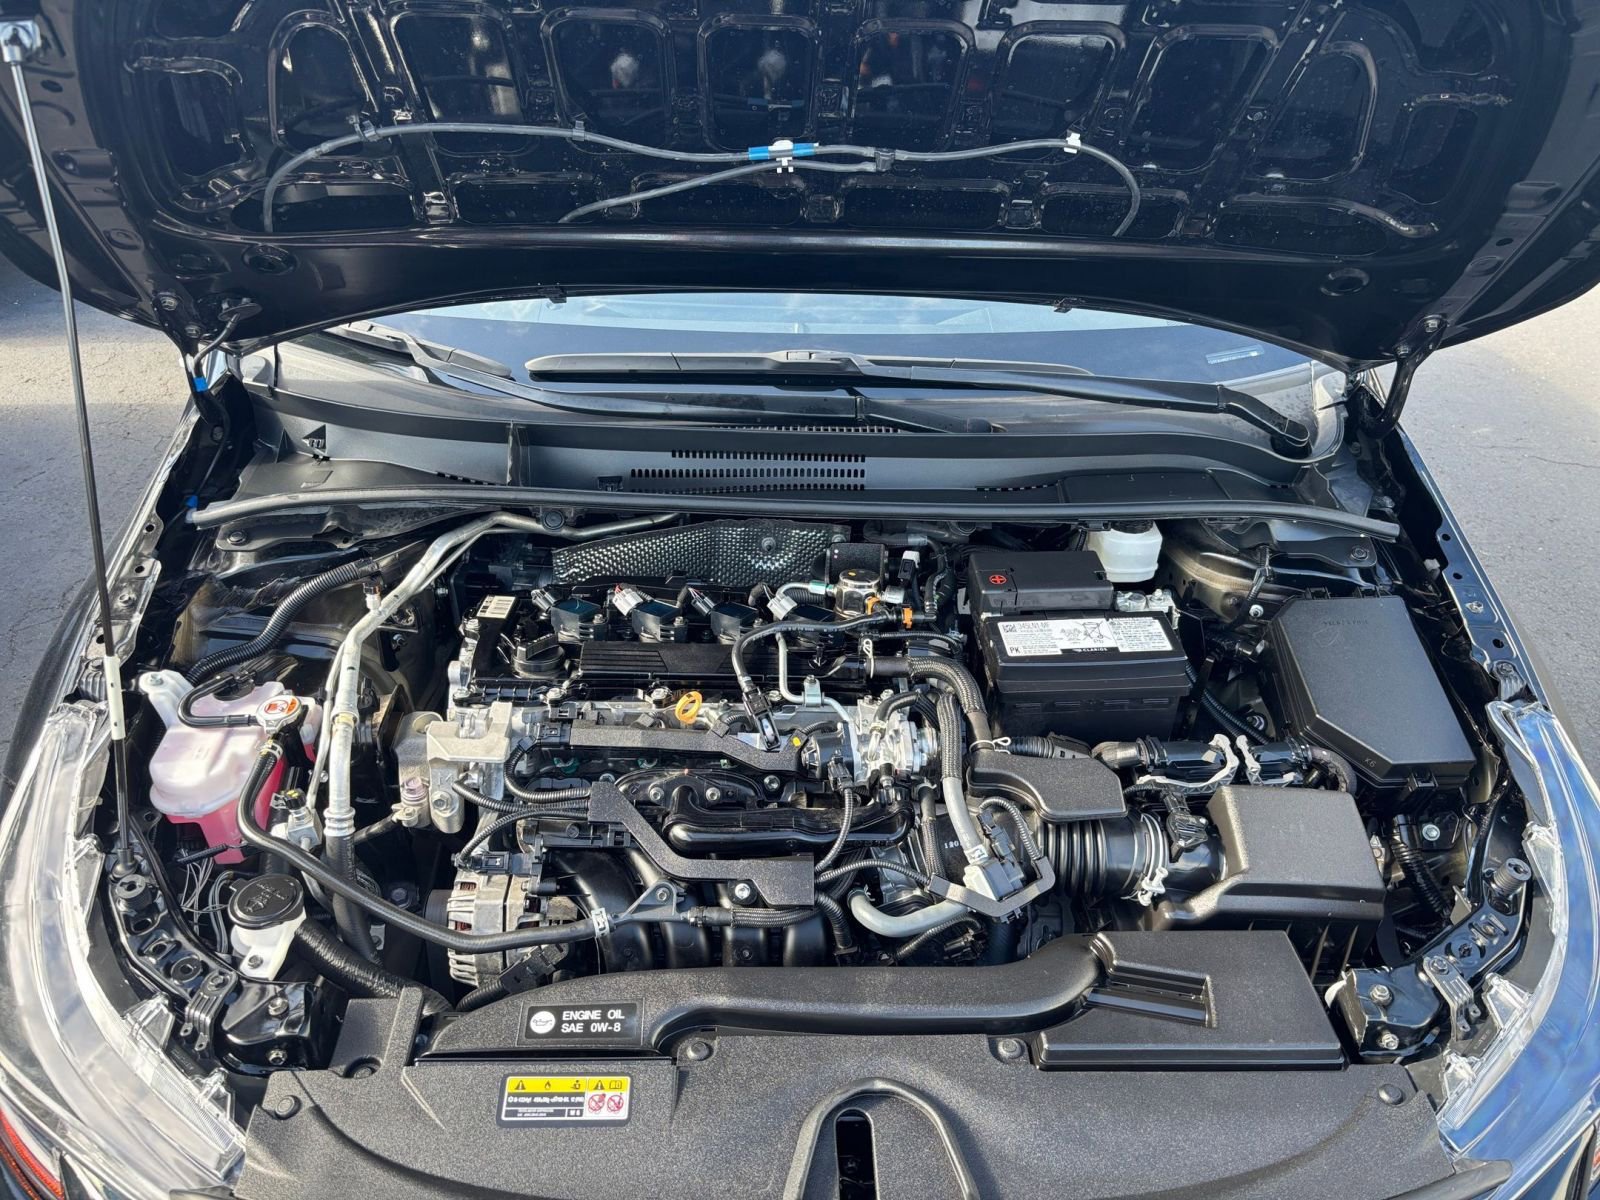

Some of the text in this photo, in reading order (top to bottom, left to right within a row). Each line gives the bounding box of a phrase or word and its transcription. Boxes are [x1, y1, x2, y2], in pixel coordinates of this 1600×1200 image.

[1009, 646, 1021, 654] PK
[562, 1008, 625, 1021] ENGINE OIL
[561, 1022, 622, 1033] SAE 0W-8
